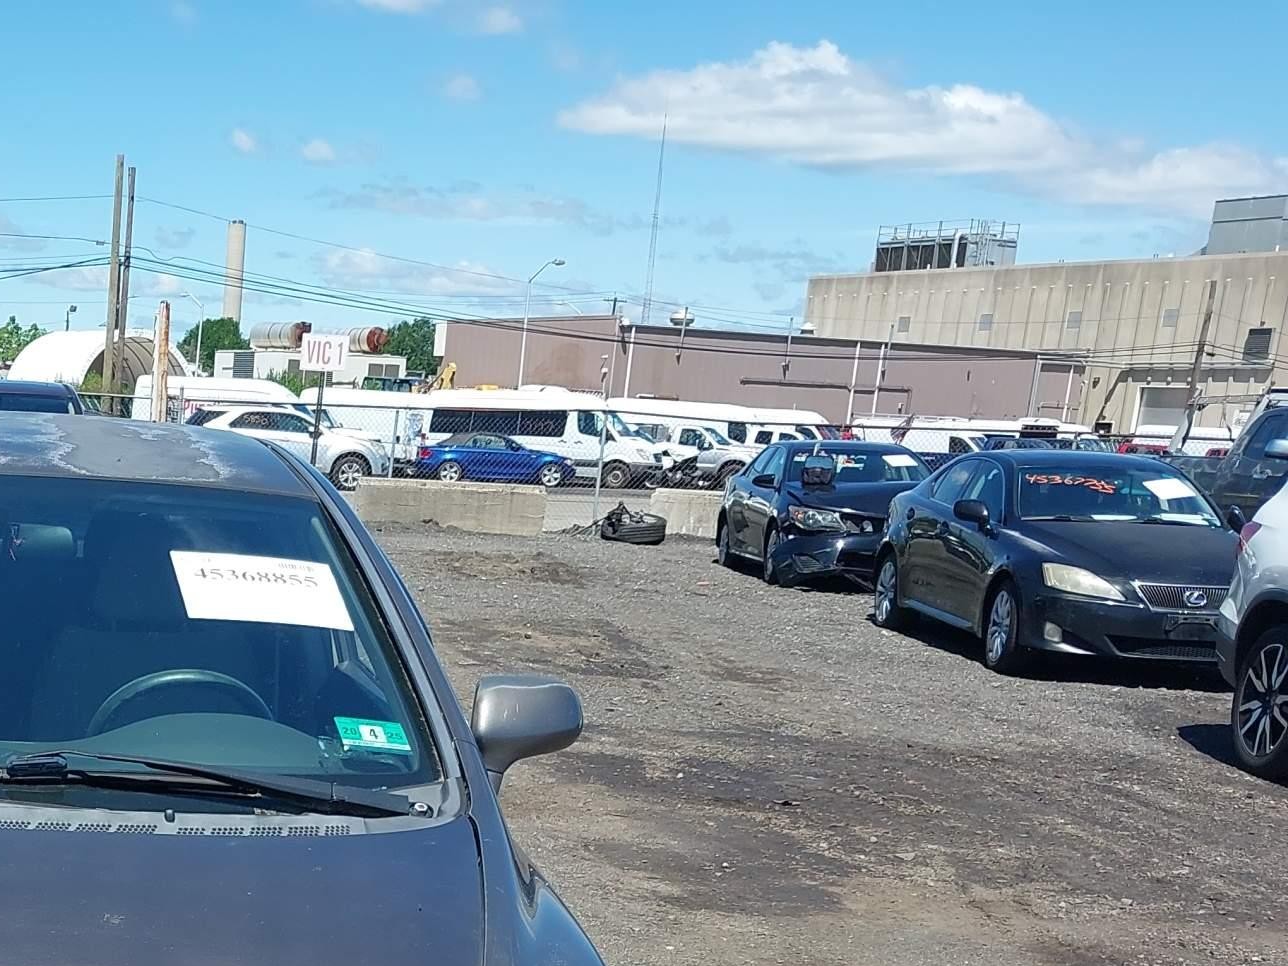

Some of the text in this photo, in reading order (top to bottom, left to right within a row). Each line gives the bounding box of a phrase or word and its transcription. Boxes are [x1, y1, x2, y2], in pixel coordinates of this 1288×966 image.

[307, 340, 344, 365] VIC 1
[194, 567, 319, 587] 45368855
[369, 728, 379, 740] 4
